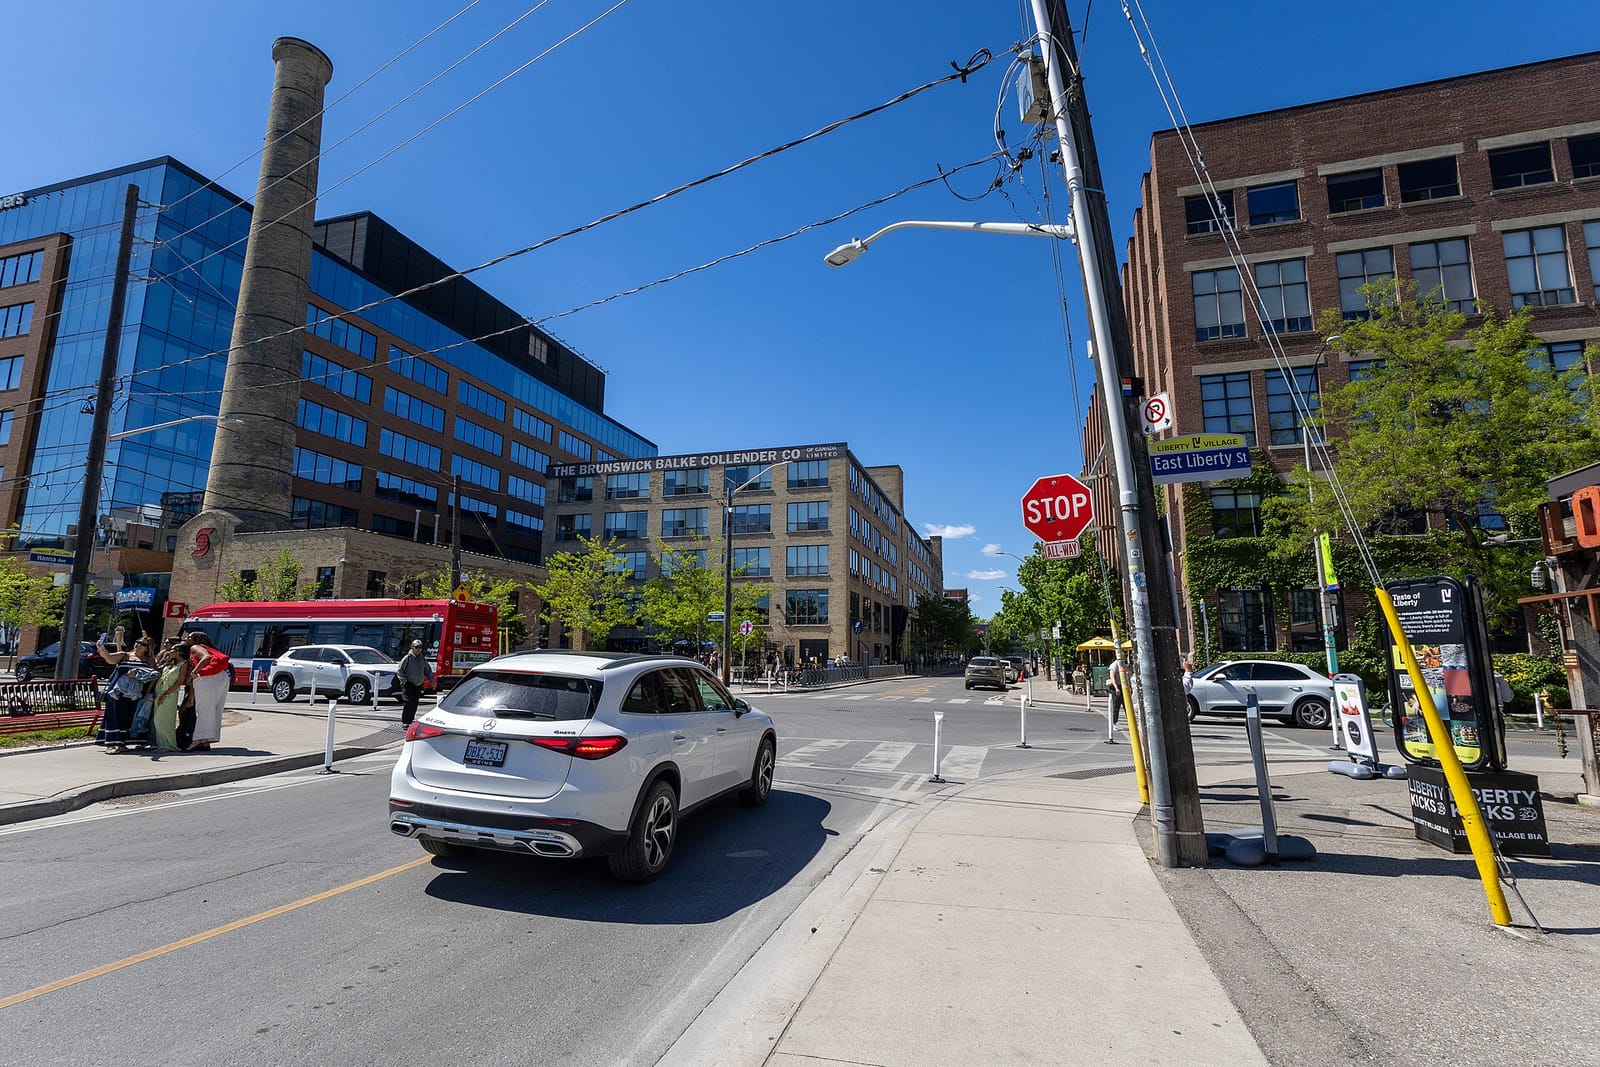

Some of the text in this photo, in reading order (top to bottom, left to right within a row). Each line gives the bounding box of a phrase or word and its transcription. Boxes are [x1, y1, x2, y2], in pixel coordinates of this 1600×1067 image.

[1157, 442, 1190, 452] LIBERTY
[1203, 438, 1239, 447] VILLAGE
[553, 448, 801, 476] THE BRUNSWICK BALKE COLLENDER CO
[806, 451, 838, 459] LIMITED
[1154, 451, 1248, 471] East Liberty St
[1027, 493, 1087, 524] STOP
[37, 554, 57, 563] Hanna
[1047, 543, 1077, 557] ALL-WAY
[1408, 778, 1443, 800] LIBERTY
[1448, 788, 1537, 805] LERTY
[1410, 793, 1437, 813] KICKS
[1450, 804, 1515, 820] KKS
